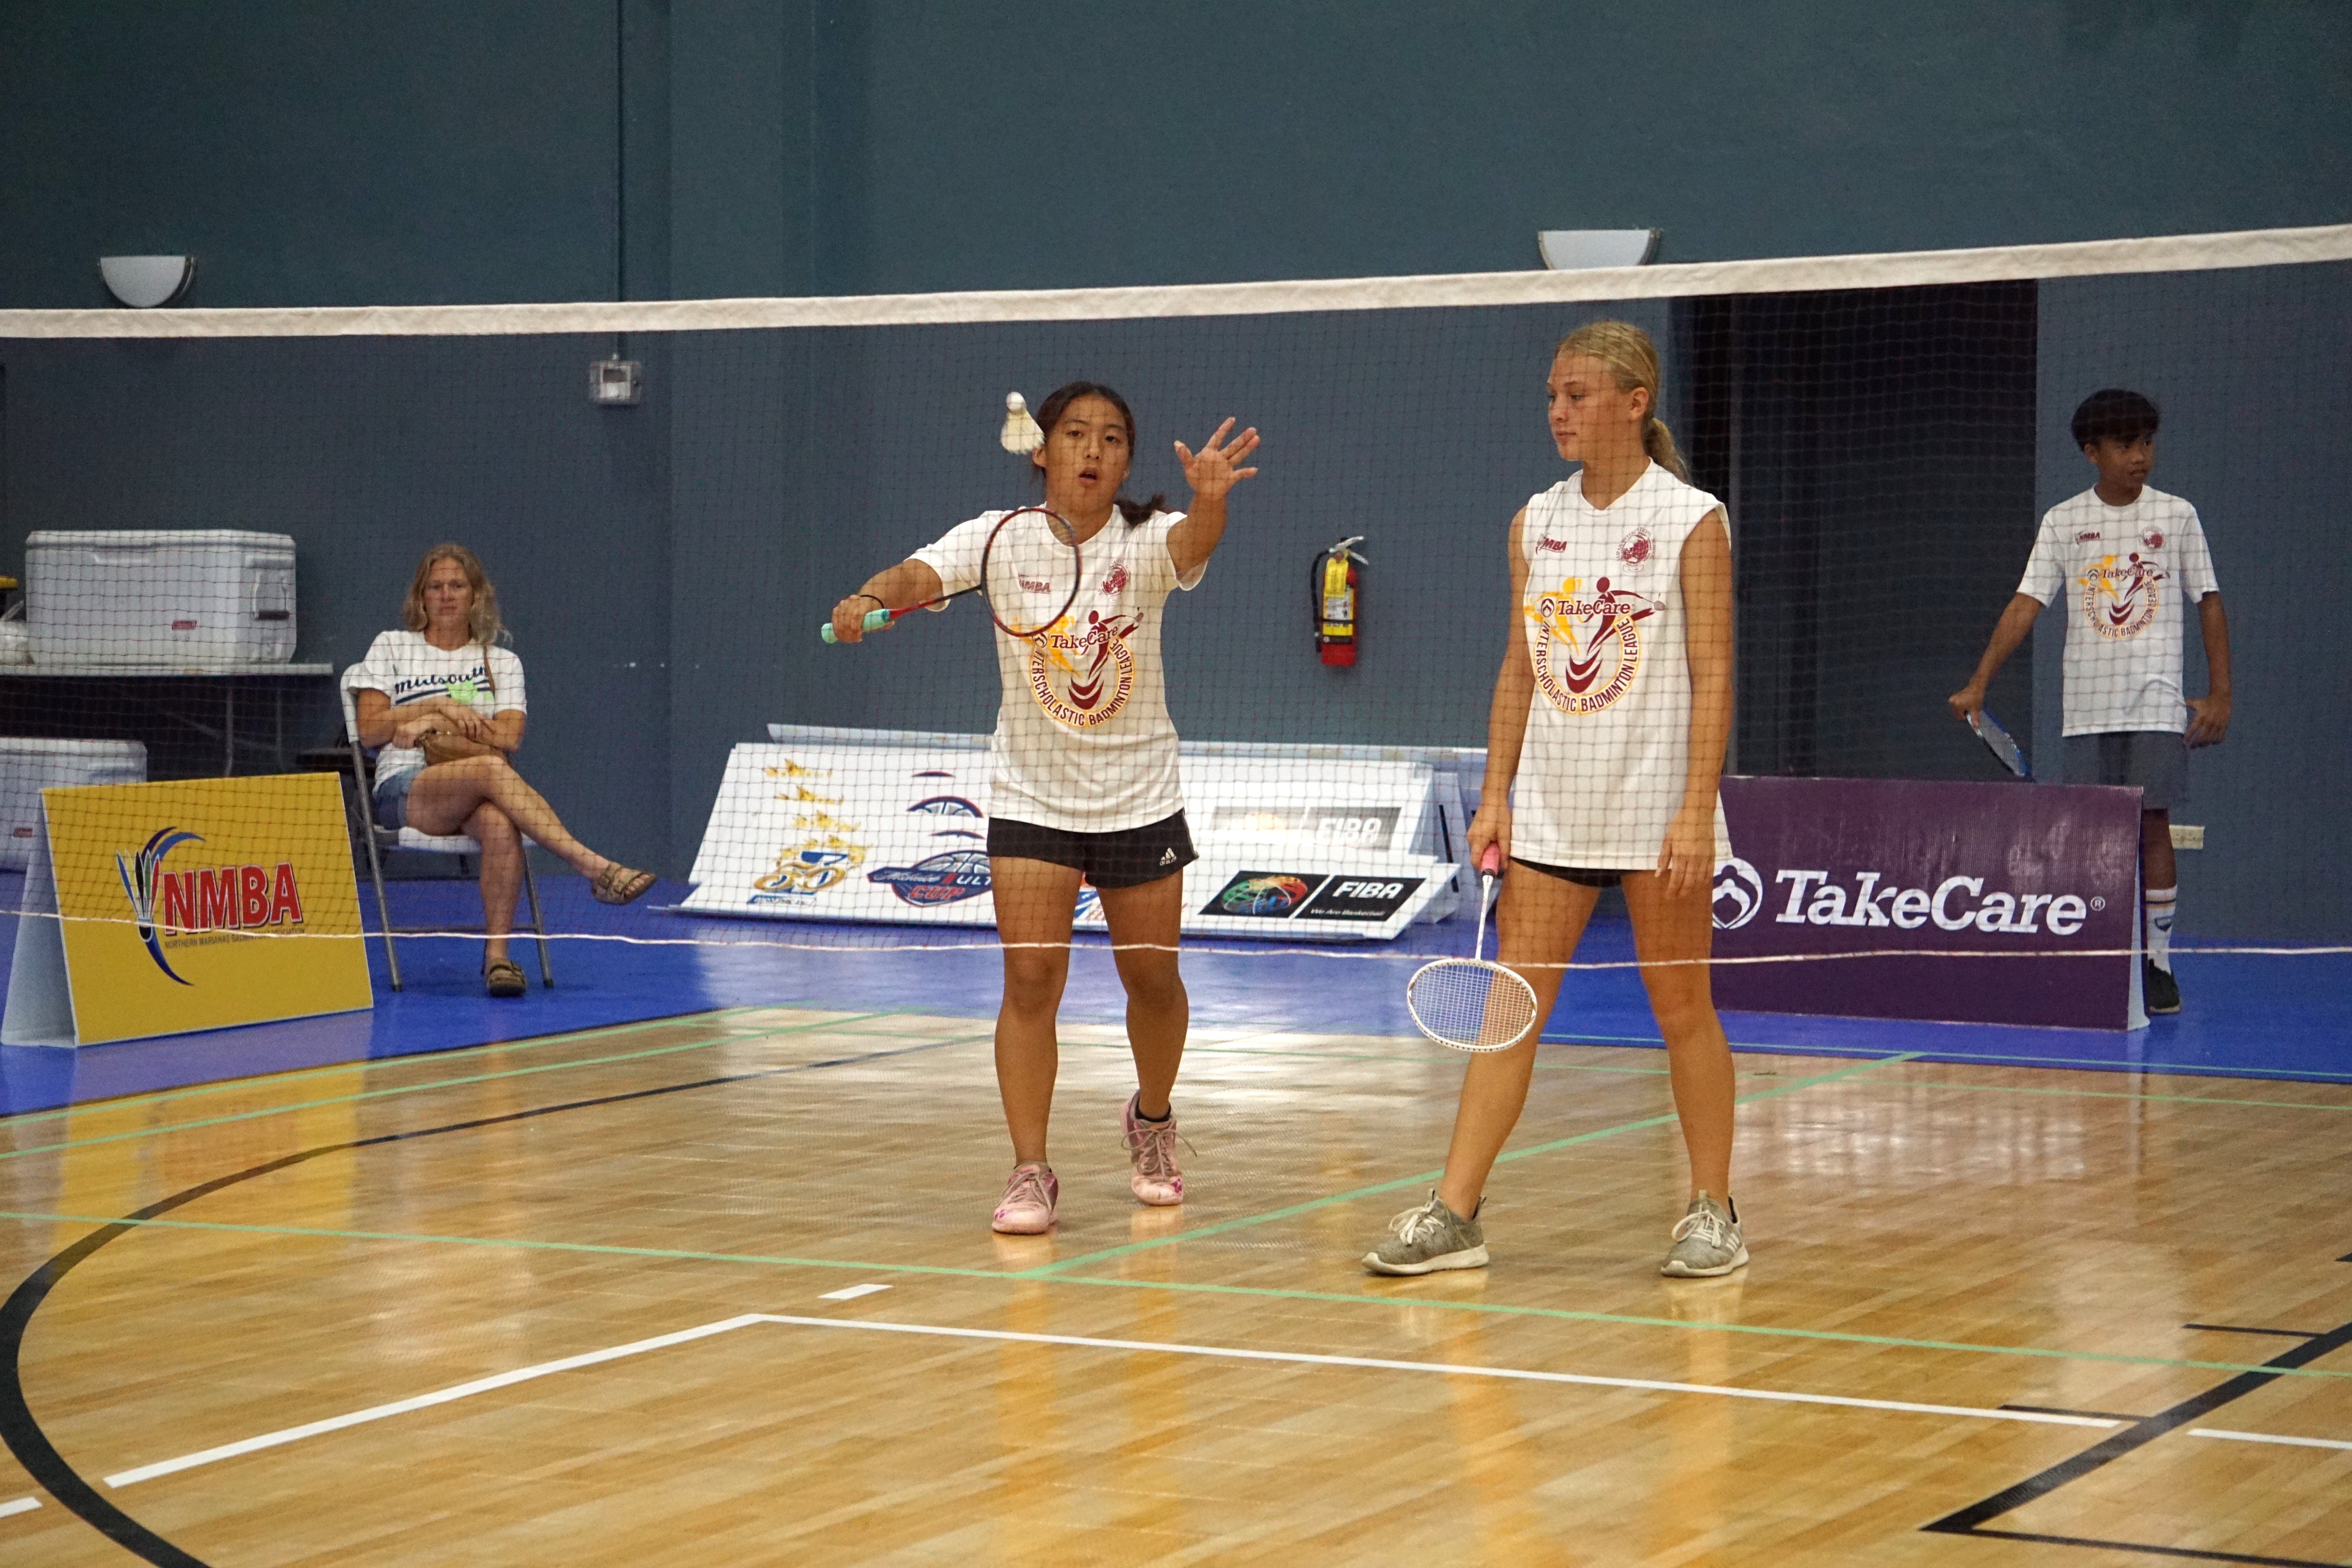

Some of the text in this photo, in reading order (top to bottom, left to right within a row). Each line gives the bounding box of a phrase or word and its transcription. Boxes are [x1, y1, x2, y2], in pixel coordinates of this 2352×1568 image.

[2085, 581, 2118, 637] INTERSCHOASTIC
[1109, 638, 1133, 675] LEAGUE
[1535, 617, 1638, 712] INTERSCHOLASTIC BADMINTON LEAGUE
[1088, 677, 1132, 726] BADMINTON
[1316, 817, 1383, 844] FIBA
[163, 861, 303, 936] NMBA
[908, 885, 965, 900] CUP
[1332, 881, 1405, 899] FIBA
